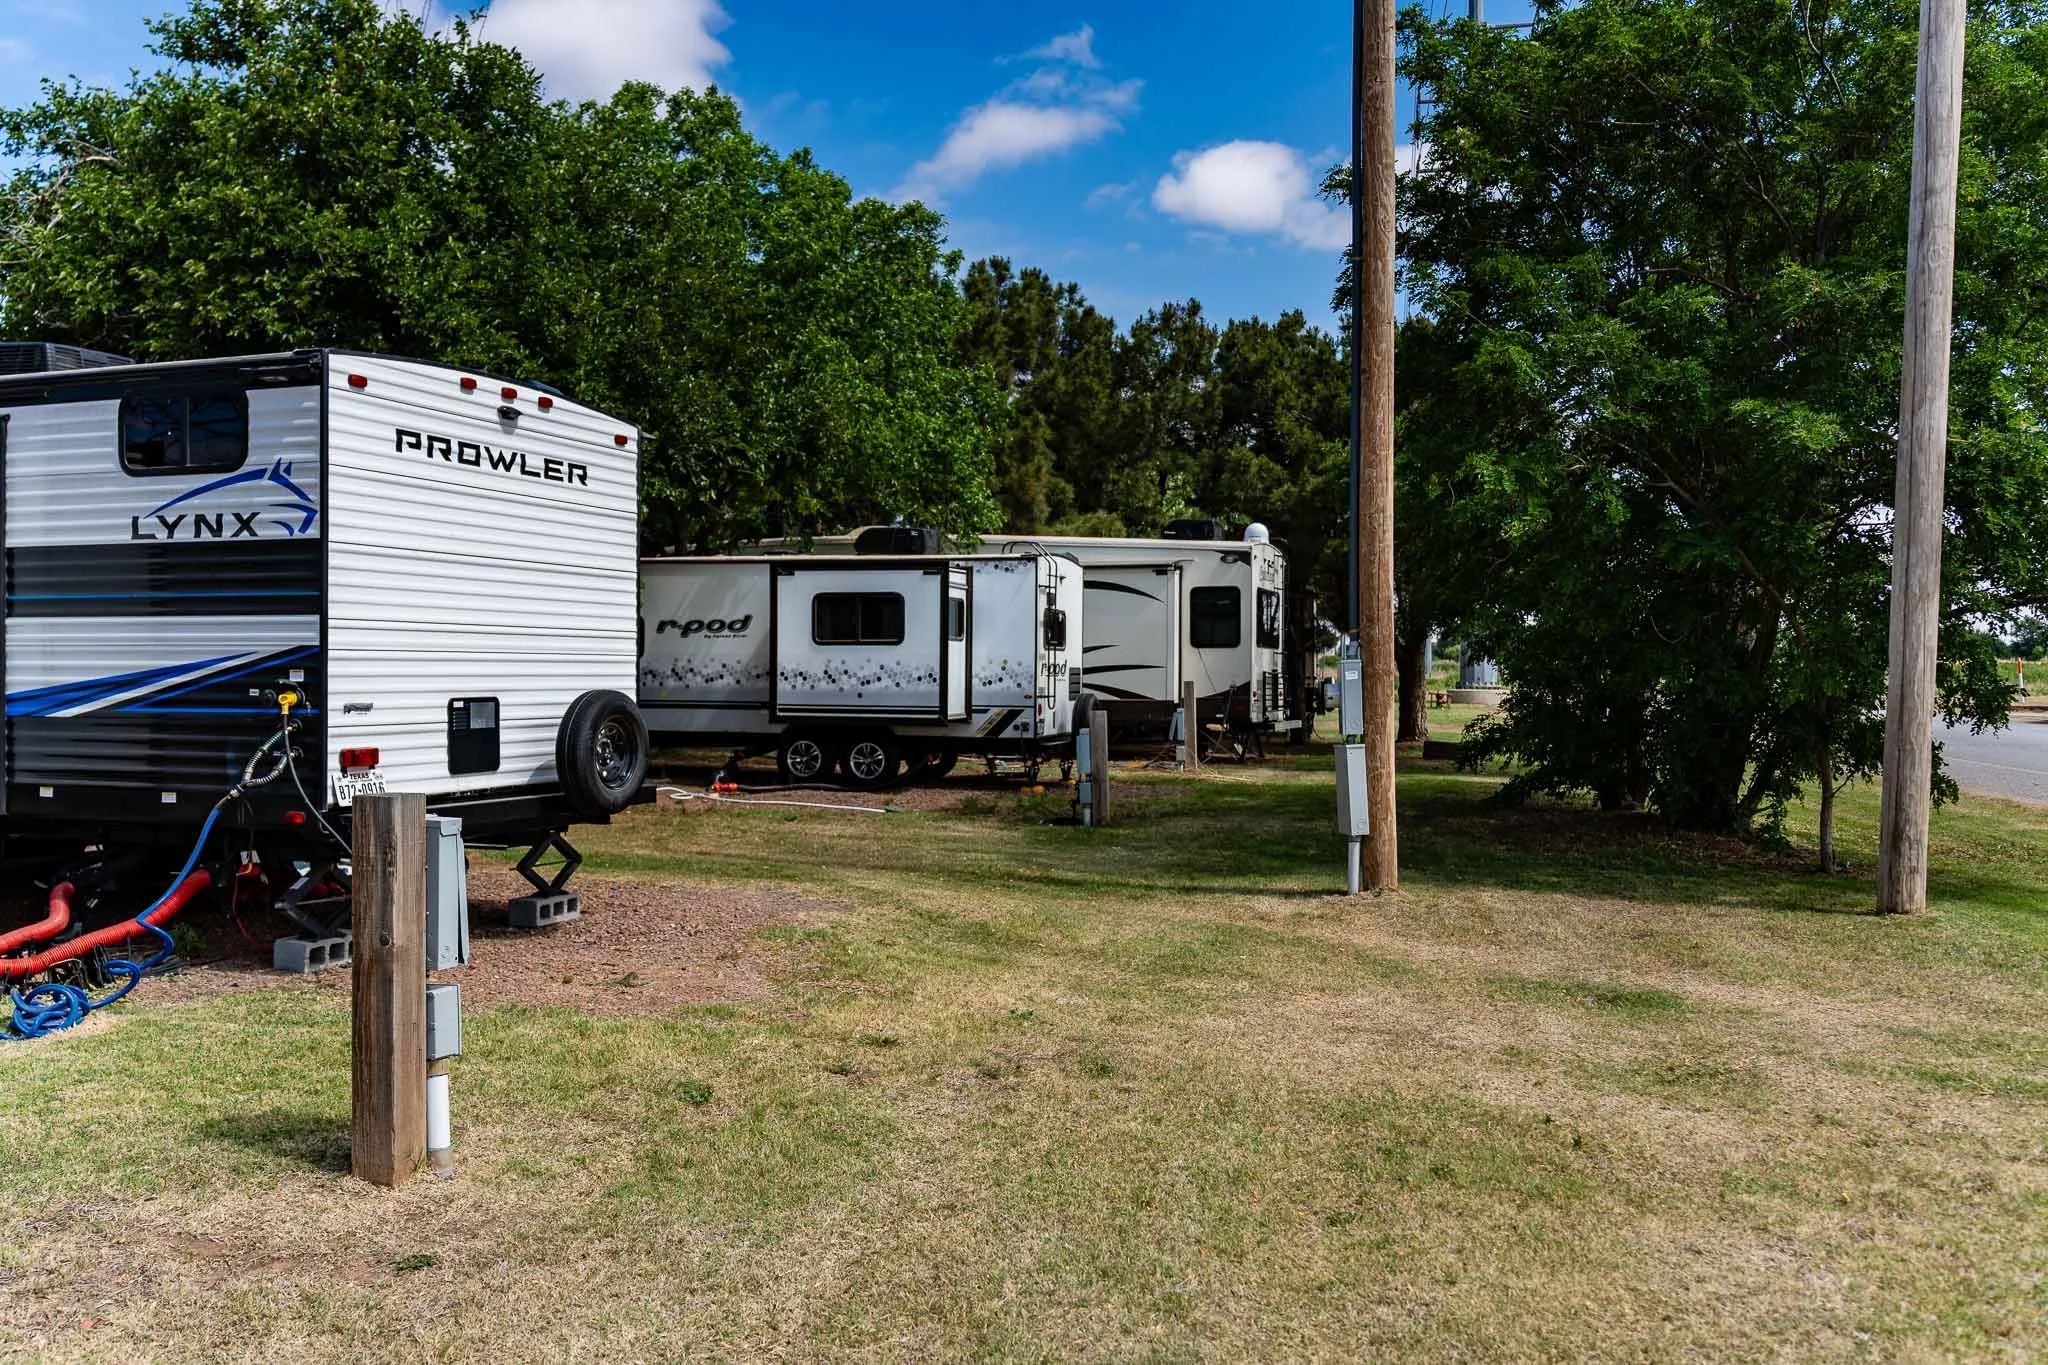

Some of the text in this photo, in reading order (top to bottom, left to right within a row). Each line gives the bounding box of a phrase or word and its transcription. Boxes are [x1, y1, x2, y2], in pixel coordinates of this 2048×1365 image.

[395, 428, 589, 486] PROWLER
[131, 512, 261, 540] LYNX
[349, 772, 370, 780] TEXAS
